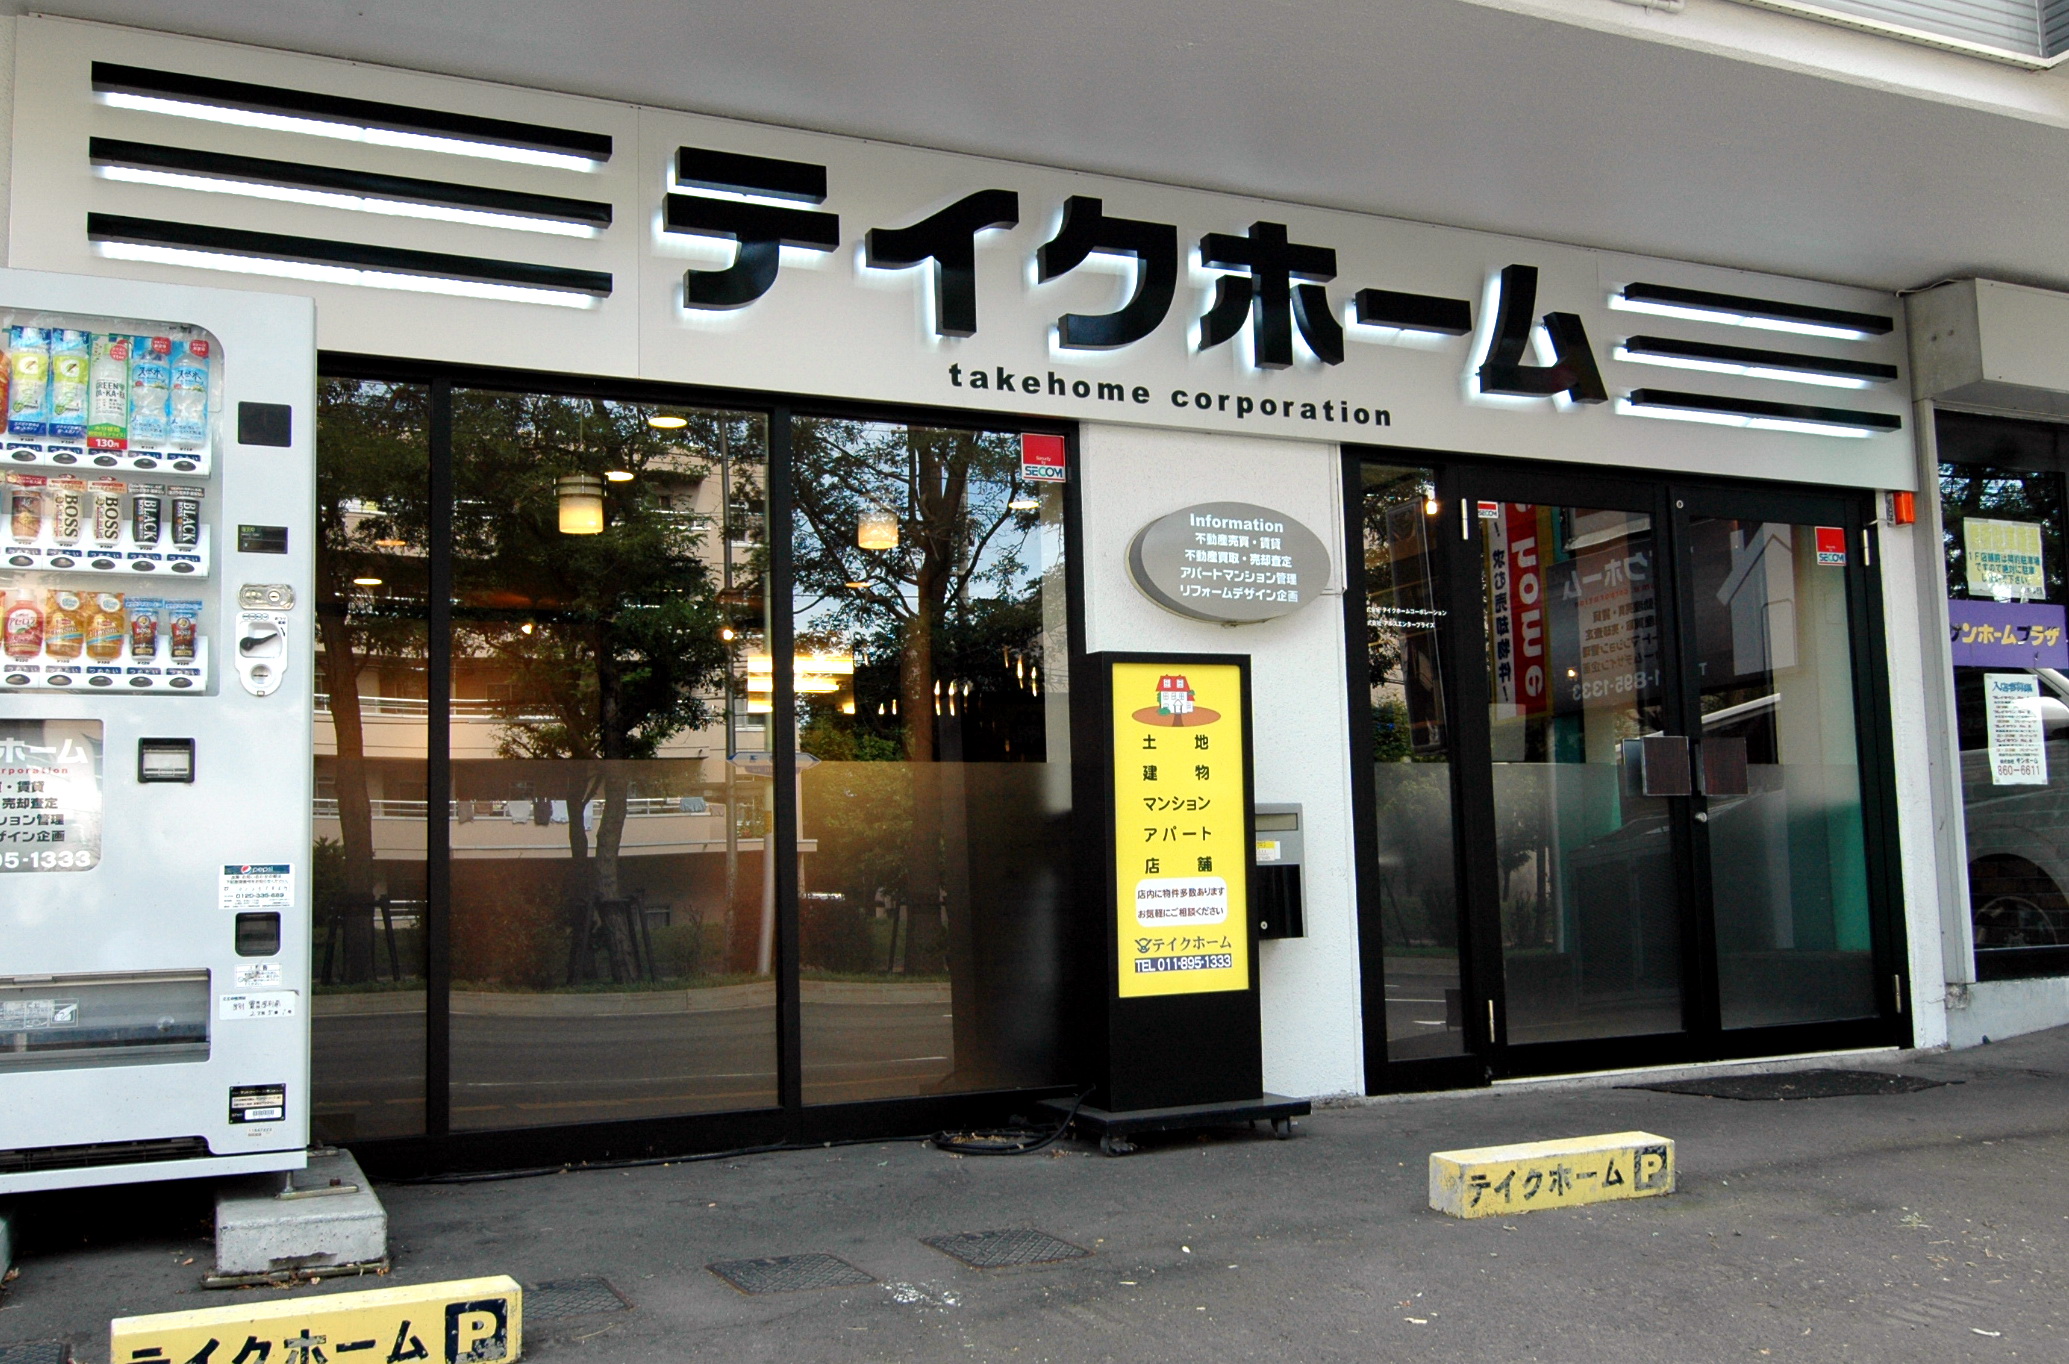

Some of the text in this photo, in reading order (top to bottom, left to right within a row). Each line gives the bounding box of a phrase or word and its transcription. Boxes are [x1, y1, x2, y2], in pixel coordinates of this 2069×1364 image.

[662, 145, 1610, 405] テイクホーム
[949, 362, 1393, 428] takehome corporation
[1025, 466, 1063, 478] SECOM
[64, 494, 79, 538] BOSS
[104, 496, 119, 540] BOSS
[144, 500, 158, 540] BLACK
[183, 501, 196, 543] BLACK
[1190, 513, 1284, 533] Information
[1195, 532, 1281, 551] 不動産売買・賃貸
[1184, 549, 1293, 568] 不動産買取・売却査定
[1818, 553, 1845, 562] SECOM
[1180, 567, 1297, 586] アパートマンション管理
[1180, 584, 1299, 603] リフォームデザイン企画
[2, 797, 59, 809] 売却査定
[1143, 796, 1211, 811] マンション
[1144, 825, 1212, 842] アパート
[0, 850, 91, 869] 5-1333
[252, 865, 274, 874] pepsi
[1137, 886, 1225, 899] 店内に物件多数あります
[1137, 907, 1224, 919] お気軽にご相談ください
[1152, 935, 1232, 952] テイクホーム
[1136, 959, 1156, 972] TEL
[1470, 1153, 1664, 1208] テイクホーム P
[457, 1311, 497, 1353] P
